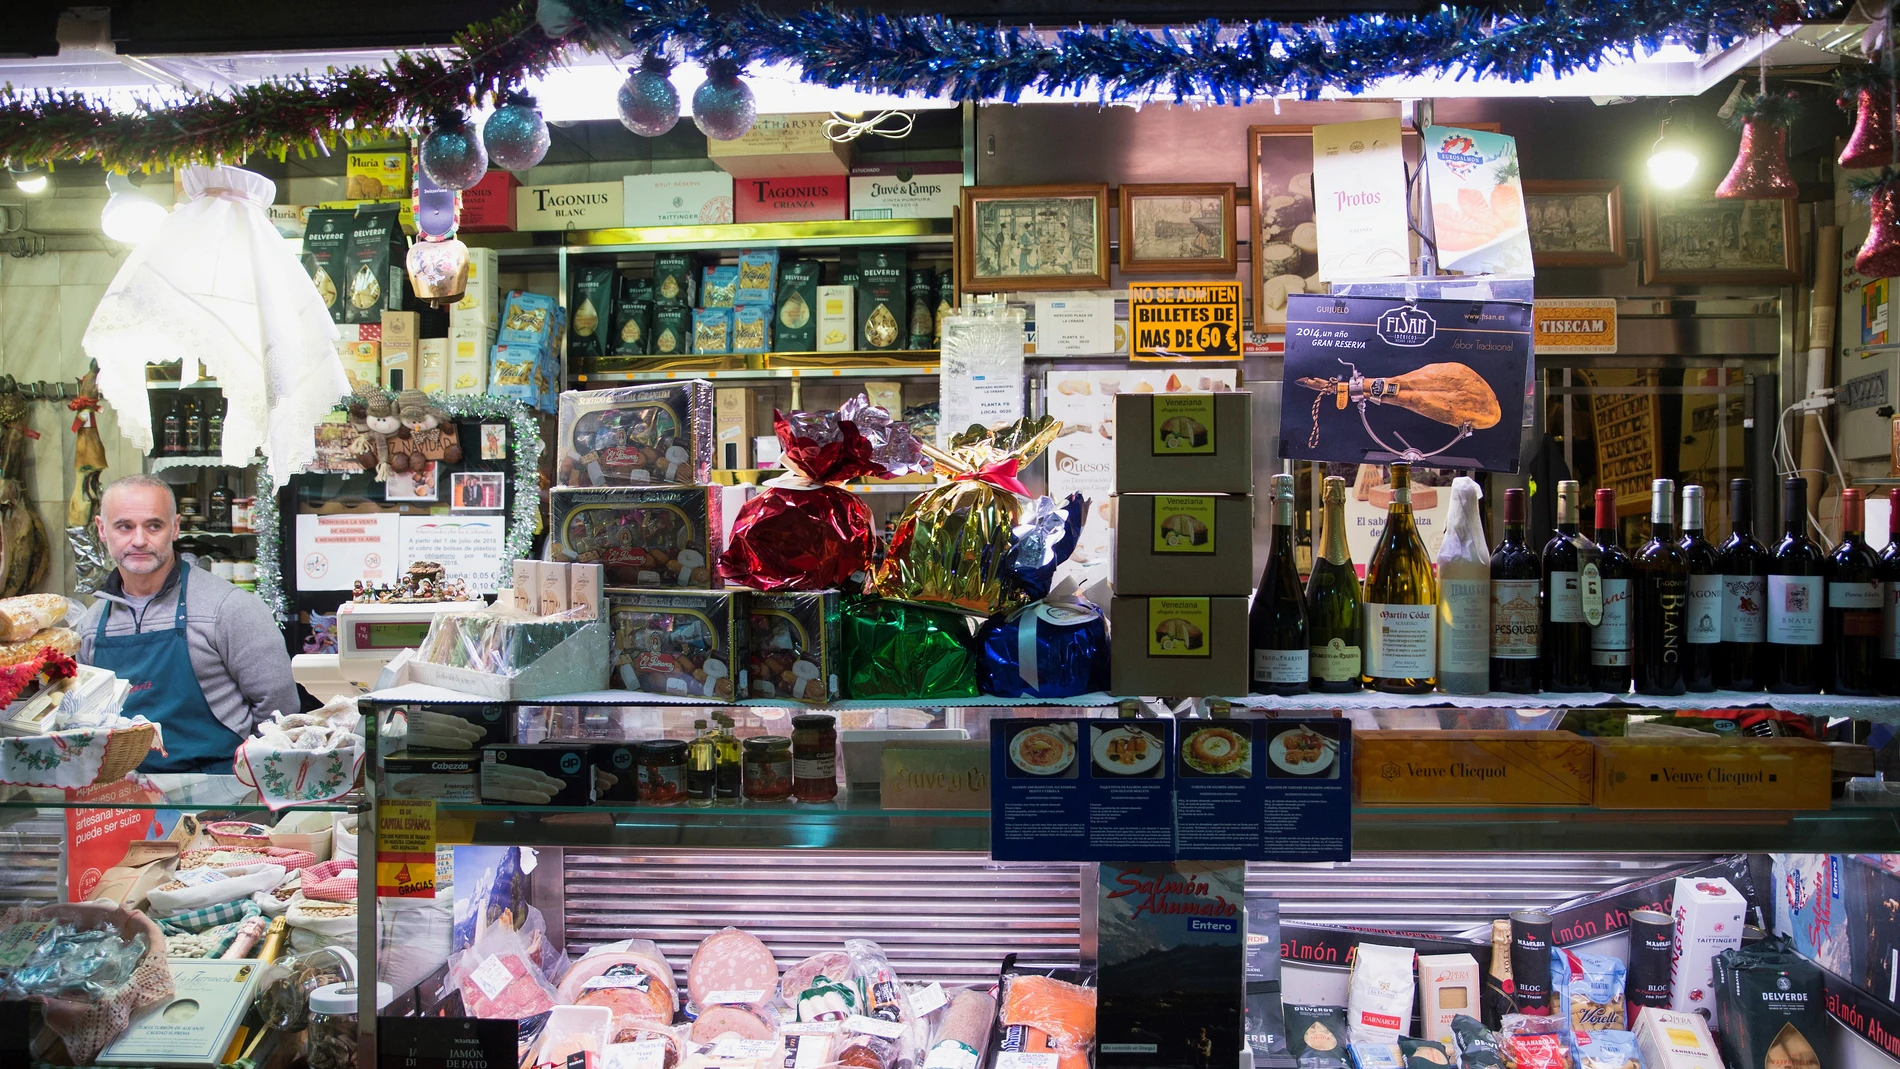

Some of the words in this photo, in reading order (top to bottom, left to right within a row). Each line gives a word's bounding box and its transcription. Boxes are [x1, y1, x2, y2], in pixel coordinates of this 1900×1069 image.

[351, 153, 379, 168] Nuria
[1440, 153, 1481, 164] EUROSALMON
[752, 180, 829, 203] TAGONIUS
[871, 182, 899, 198] Juvé
[899, 186, 908, 194] &
[907, 182, 941, 197] Camps
[533, 188, 608, 211] TAGONIUS
[773, 201, 815, 209] CRIANZA
[1333, 190, 1381, 212] Protos
[555, 208, 586, 217] BLANC
[658, 213, 699, 221] TAITTINGER
[308, 233, 344, 241] DELVERDE
[354, 228, 387, 237] DELVERDE
[1133, 287, 1153, 303] NO
[1156, 287, 1175, 303] SE
[1176, 286, 1237, 303] ADMITEN
[1139, 307, 1210, 323] BILLETES
[1213, 307, 1234, 322] DE
[1316, 305, 1350, 314] GUIJUELO
[1464, 312, 1506, 321] www.fisan.es
[1386, 311, 1427, 334] FISAN
[1540, 320, 1604, 333] TISECAM
[1139, 328, 1171, 348] MAS
[1175, 328, 1193, 348] DE
[1200, 326, 1221, 348] 50
[1225, 327, 1238, 348] €
[1334, 330, 1349, 338] año
[1311, 339, 1333, 348] GRAN
[1334, 339, 1367, 349] RESERVA
[1450, 338, 1474, 350] Sabor
[1475, 339, 1515, 351] Tradicional
[1165, 398, 1203, 406] Veneziana
[1061, 458, 1111, 476] Quesos
[1167, 497, 1204, 506] Veneziana
[1356, 516, 1366, 526] El
[472, 582, 489, 590] 0,10
[1161, 601, 1199, 609] Veneziana
[1379, 610, 1408, 620] Martín
[1495, 624, 1539, 635] PESQUERA
[1659, 594, 1686, 663] BLANC
[431, 761, 469, 771] Cabezón
[562, 757, 579, 769] dp
[613, 753, 631, 766] dp
[1407, 762, 1447, 778] Veuve
[1449, 761, 1507, 781] Clicquot
[1663, 768, 1704, 783] Veuve
[1706, 767, 1764, 786] Clicquot
[75, 808, 114, 831] artesanal
[380, 817, 404, 830] CAPITAL
[404, 814, 432, 831] ESPAÑOL
[75, 824, 103, 848] puede
[103, 821, 119, 834] ser
[119, 813, 142, 828] suizo
[85, 876, 97, 886] SIN
[398, 879, 434, 896] GRACIAS
[1106, 868, 1210, 899] Salmón
[1131, 893, 1238, 920] Ahumado
[1192, 919, 1232, 931] Entero
[1279, 938, 1338, 962] almón
[1519, 982, 1541, 993] BLOC
[1647, 984, 1667, 992] BLOC
[1761, 992, 1809, 1001] DELVERDE
[1294, 1005, 1334, 1014] DELVERDE
[1823, 986, 1865, 1033] Salmón
[1363, 1014, 1401, 1028] CARNAROLI
[1579, 1008, 1619, 1025] Voiello
[450, 1047, 484, 1059] JAMÓN
[446, 1059, 460, 1069] DE
[461, 1059, 488, 1069] PATO
